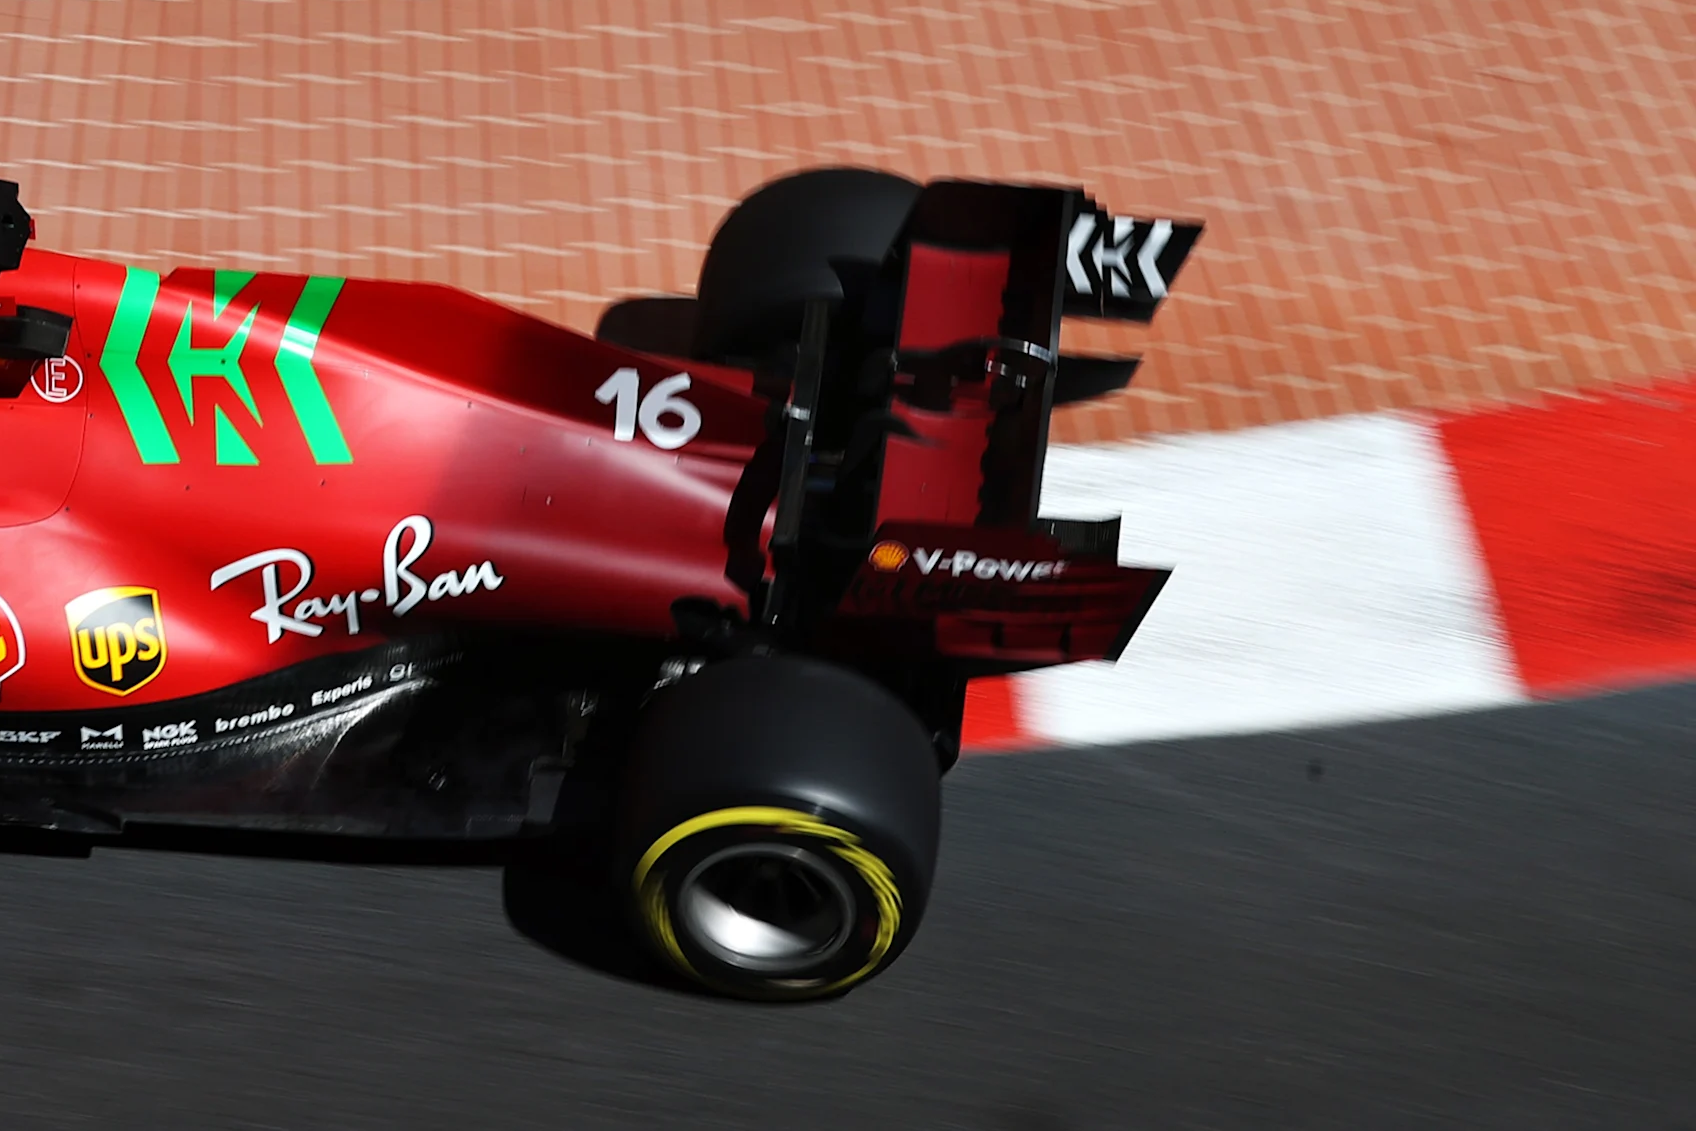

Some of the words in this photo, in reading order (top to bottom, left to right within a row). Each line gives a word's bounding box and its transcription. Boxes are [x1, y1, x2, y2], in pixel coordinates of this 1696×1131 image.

[594, 367, 702, 451] 16
[210, 514, 504, 645] Ray-Ban
[912, 547, 1070, 582] V-Power
[78, 617, 161, 682] ups
[311, 675, 373, 707] Experis
[142, 720, 197, 742] NGK
[215, 703, 295, 733] brembo
